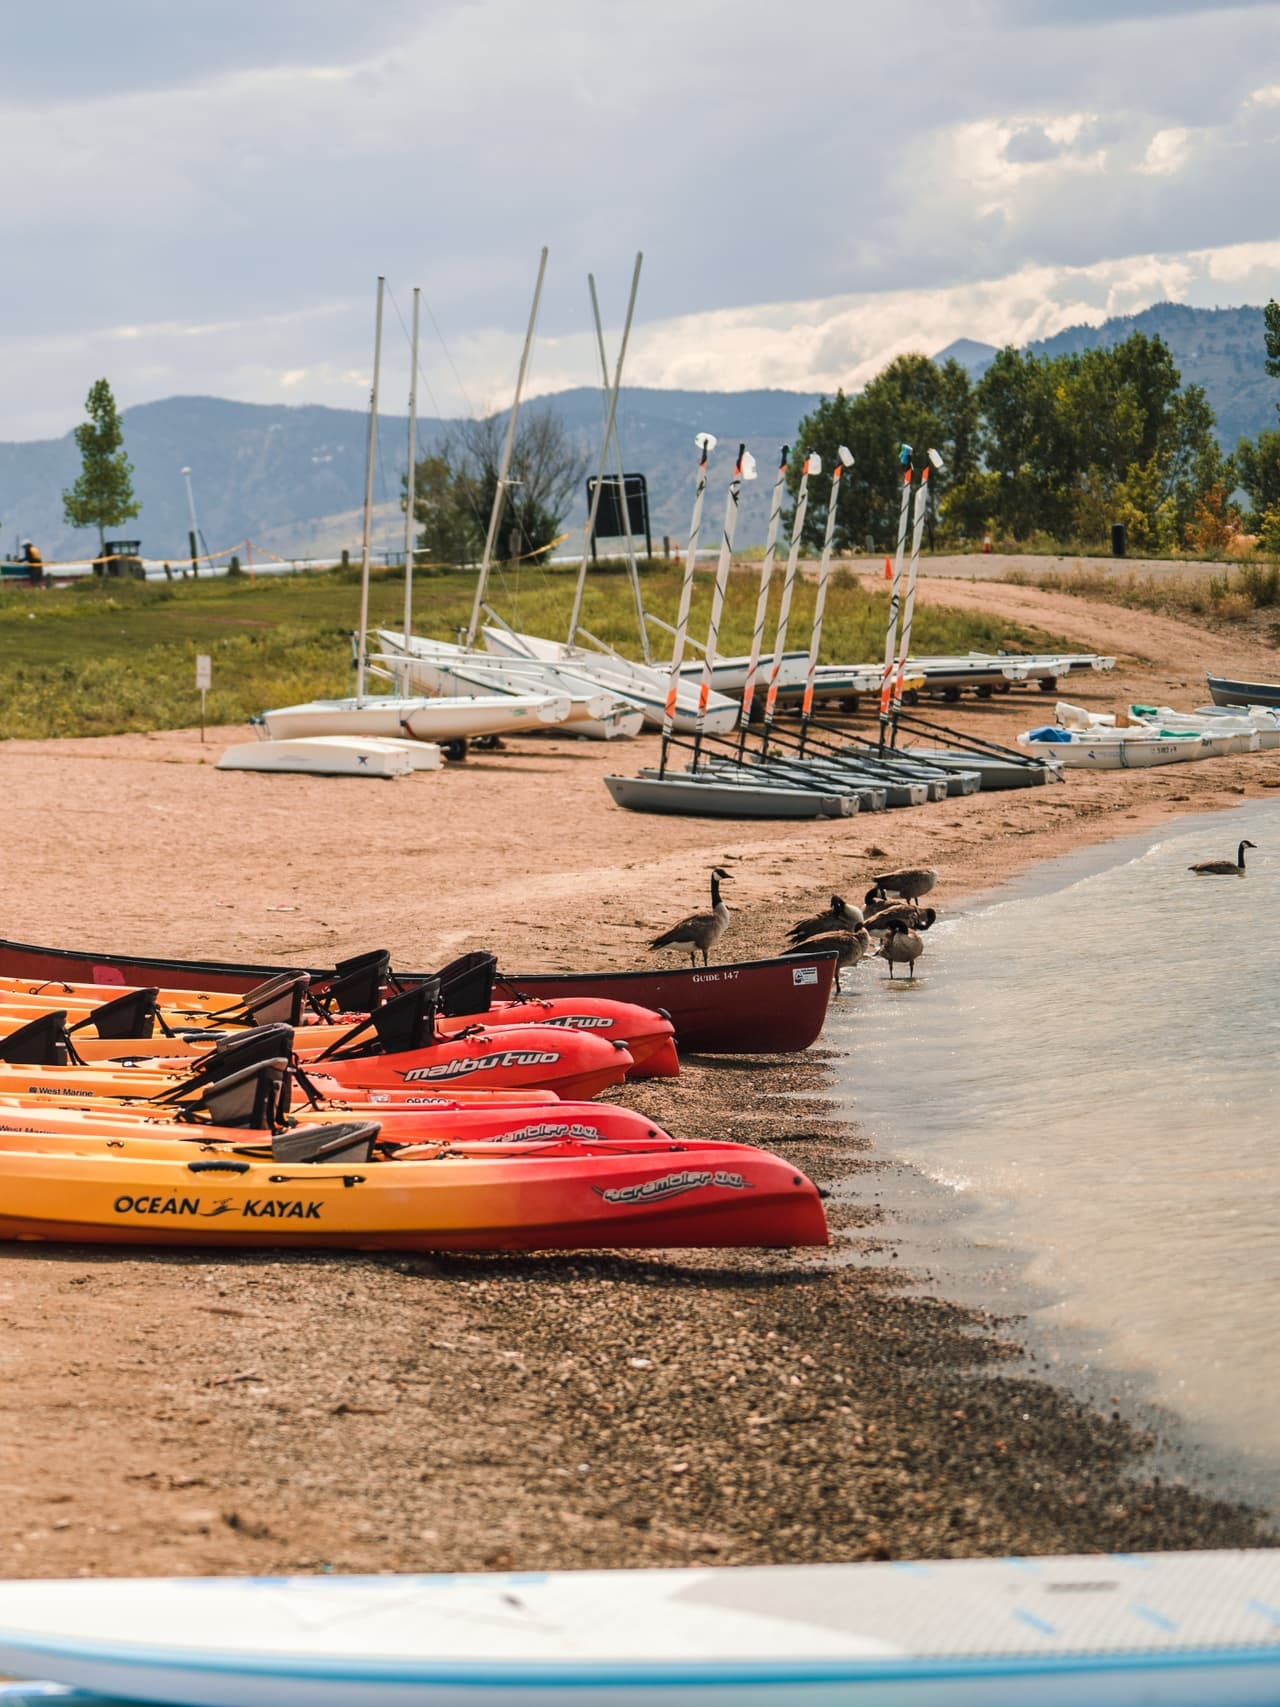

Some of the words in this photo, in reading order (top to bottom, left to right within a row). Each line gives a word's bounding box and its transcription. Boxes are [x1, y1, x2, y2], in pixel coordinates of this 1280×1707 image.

[692, 974, 720, 983] GUIDE
[723, 971, 739, 980] 147
[404, 1057, 500, 1083] malibu
[500, 1051, 561, 1067] two
[39, 1087, 61, 1096] West
[63, 1088, 94, 1098] Marine
[604, 1171, 712, 1204] scrambler
[114, 1195, 200, 1216] OCEAN
[242, 1199, 325, 1219] KAYAK
